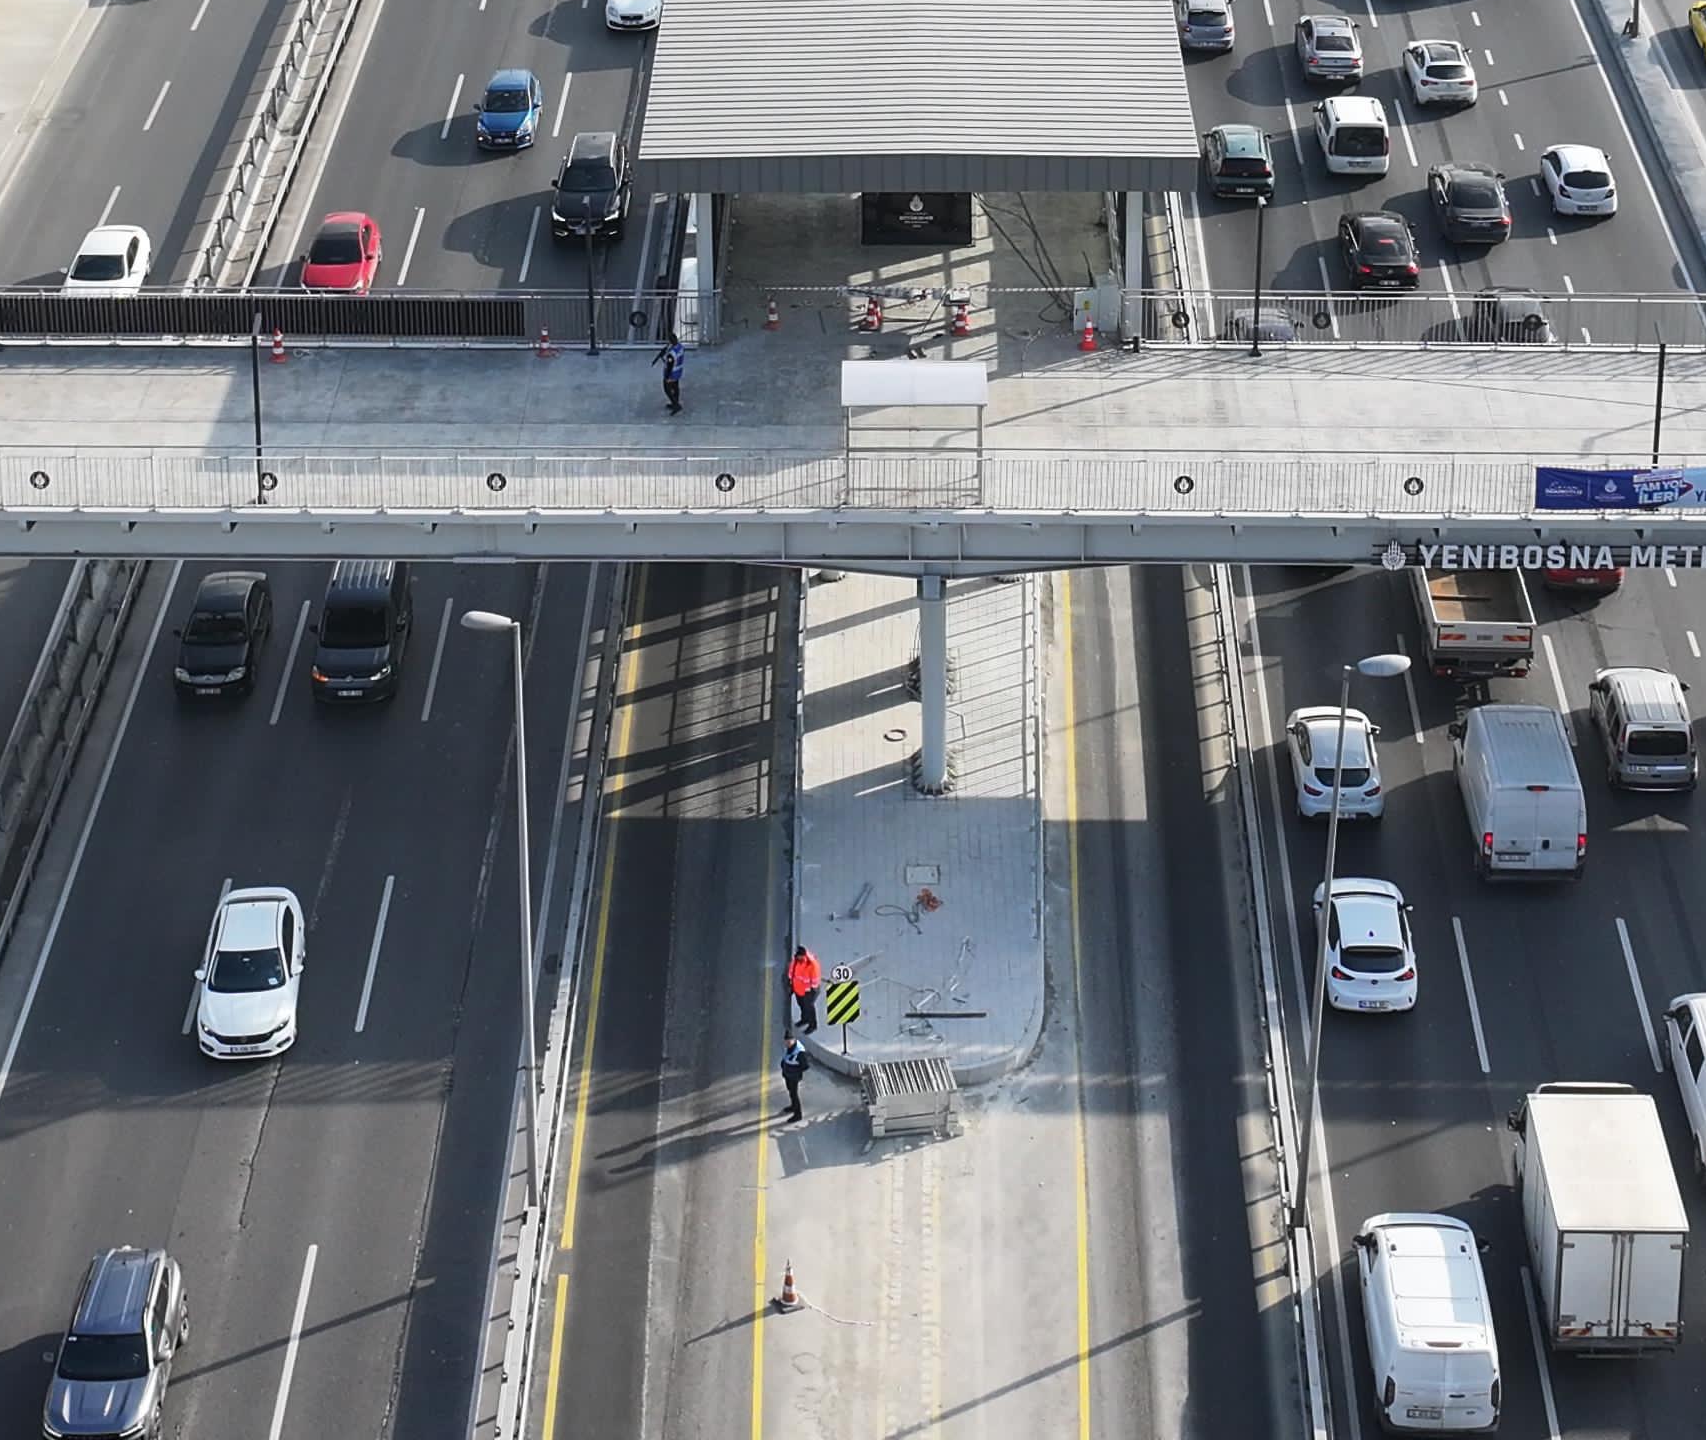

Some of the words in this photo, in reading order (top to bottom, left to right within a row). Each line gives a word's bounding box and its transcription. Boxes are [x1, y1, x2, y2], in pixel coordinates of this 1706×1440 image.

[1633, 480, 1661, 493] TAM
[1662, 479, 1687, 491] YOL
[1638, 487, 1679, 504] İLERİ
[1419, 545, 1614, 569] YENİBOSNA
[836, 968, 850, 980] 30
